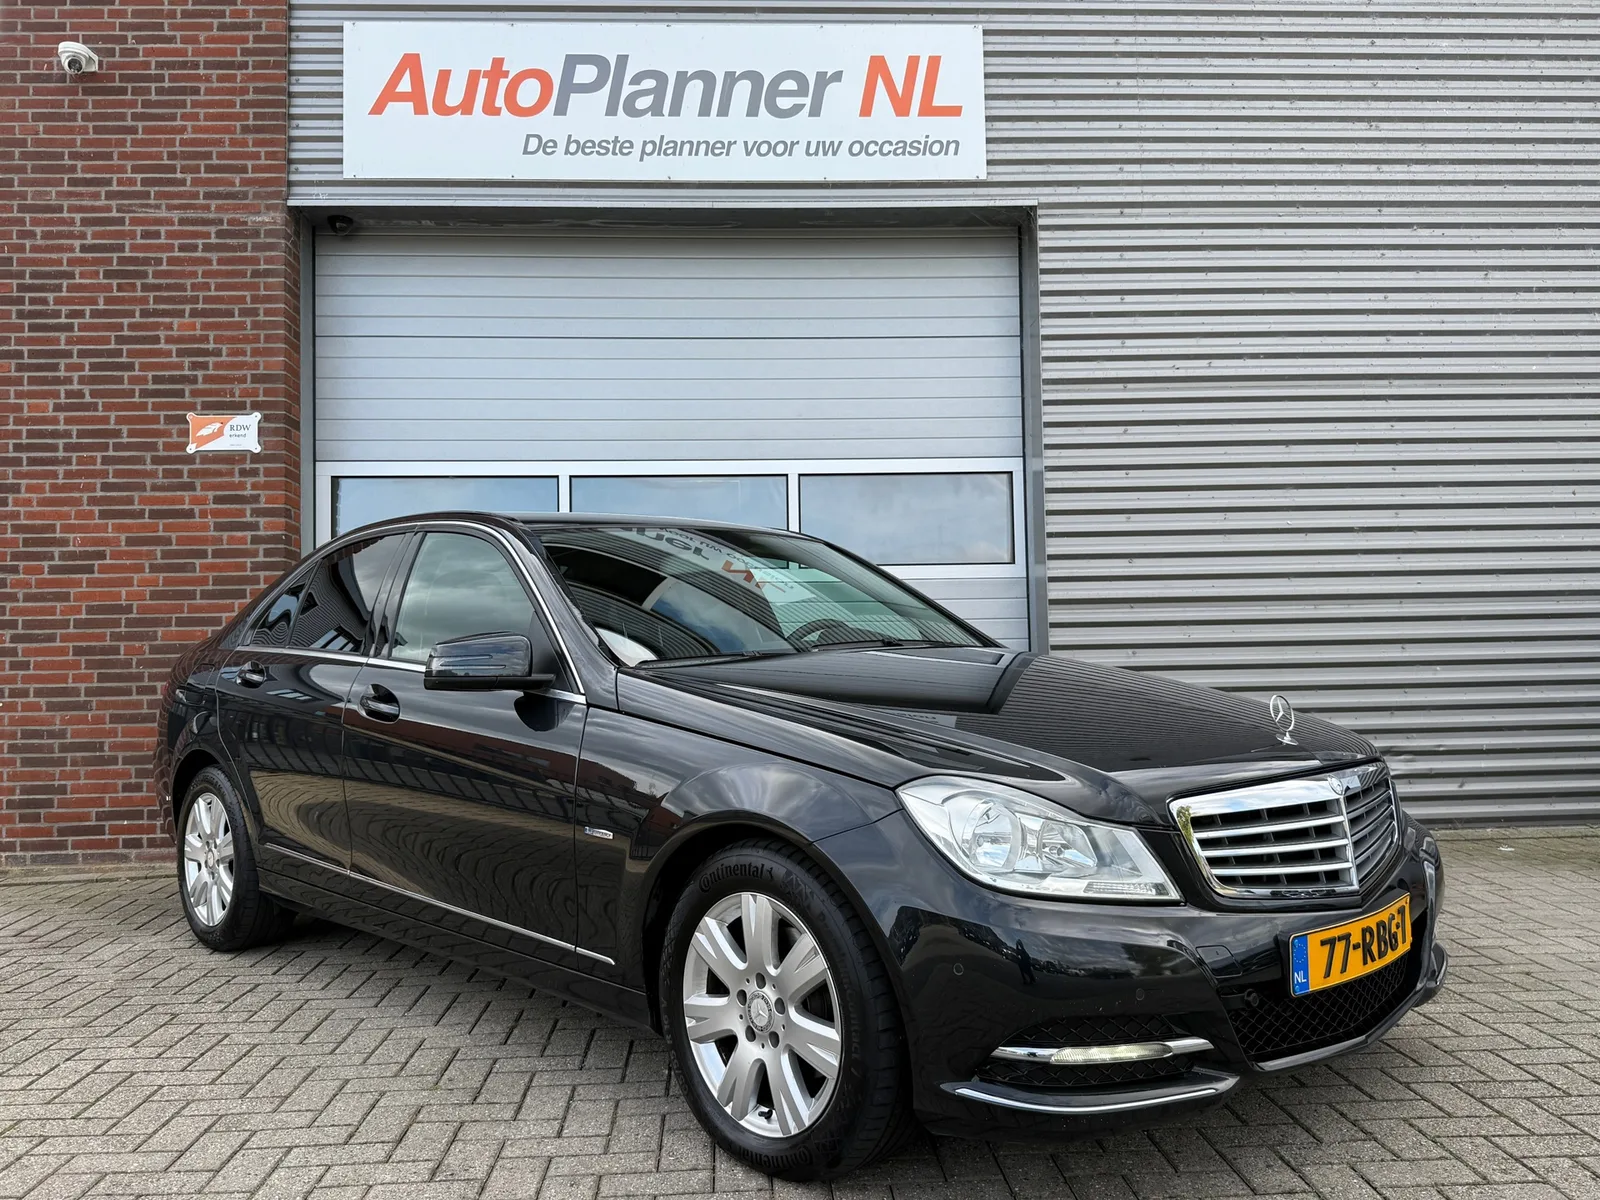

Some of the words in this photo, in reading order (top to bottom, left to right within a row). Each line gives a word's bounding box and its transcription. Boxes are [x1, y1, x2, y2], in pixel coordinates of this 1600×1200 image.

[367, 53, 844, 119] AutoPlanner
[858, 55, 963, 118] NL
[522, 134, 558, 156] De
[564, 134, 634, 157] beste
[638, 135, 738, 162] planner
[743, 140, 800, 157] voor
[805, 140, 844, 157] uw
[847, 136, 960, 157] occasion
[229, 424, 251, 432] RDW
[698, 862, 765, 893] Continental
[1320, 904, 1407, 979] 77-RBG-1
[1294, 970, 1307, 984] NL
